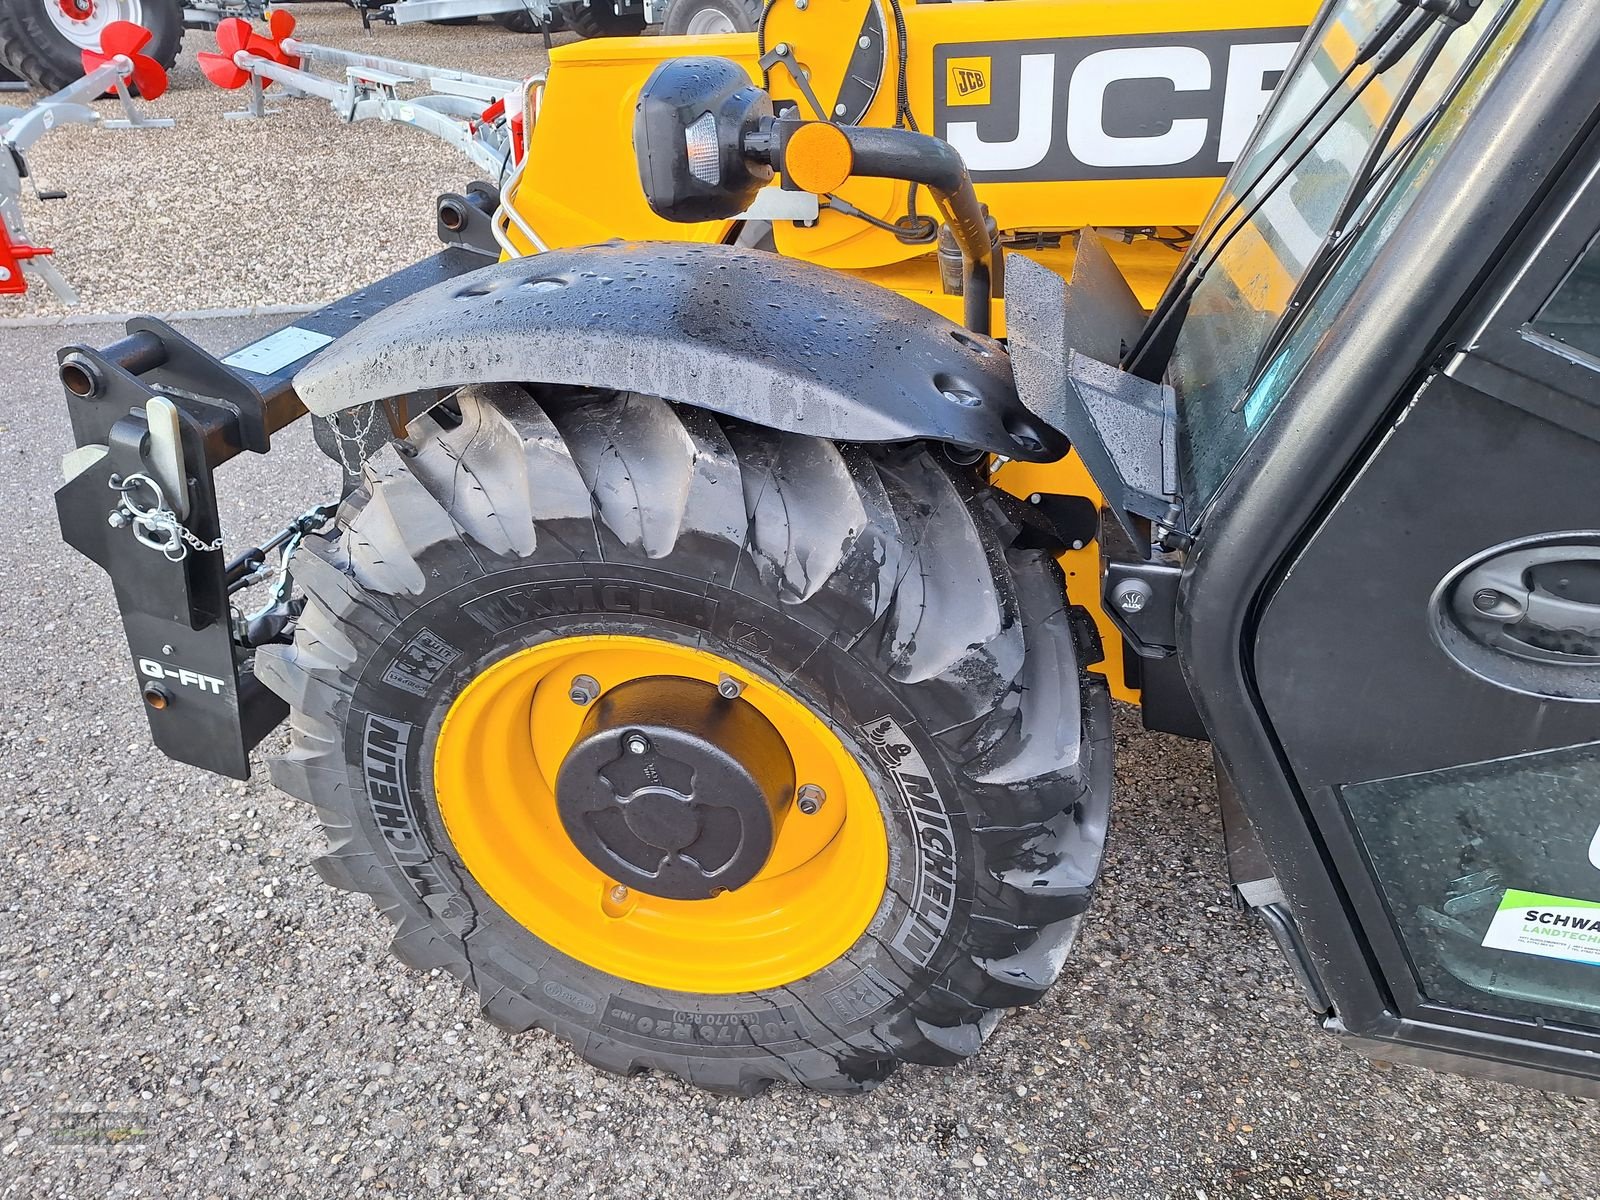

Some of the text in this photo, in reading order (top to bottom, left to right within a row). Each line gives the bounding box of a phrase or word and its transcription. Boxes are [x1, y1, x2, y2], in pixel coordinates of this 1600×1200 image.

[959, 71, 984, 93] JCB
[1121, 602, 1142, 610] AUX
[139, 658, 225, 694] Q-FIT
[366, 718, 451, 897] MICHELIN
[901, 772, 957, 963] MICHELIN
[611, 1008, 635, 1020] IND
[637, 1016, 691, 1040] R20
